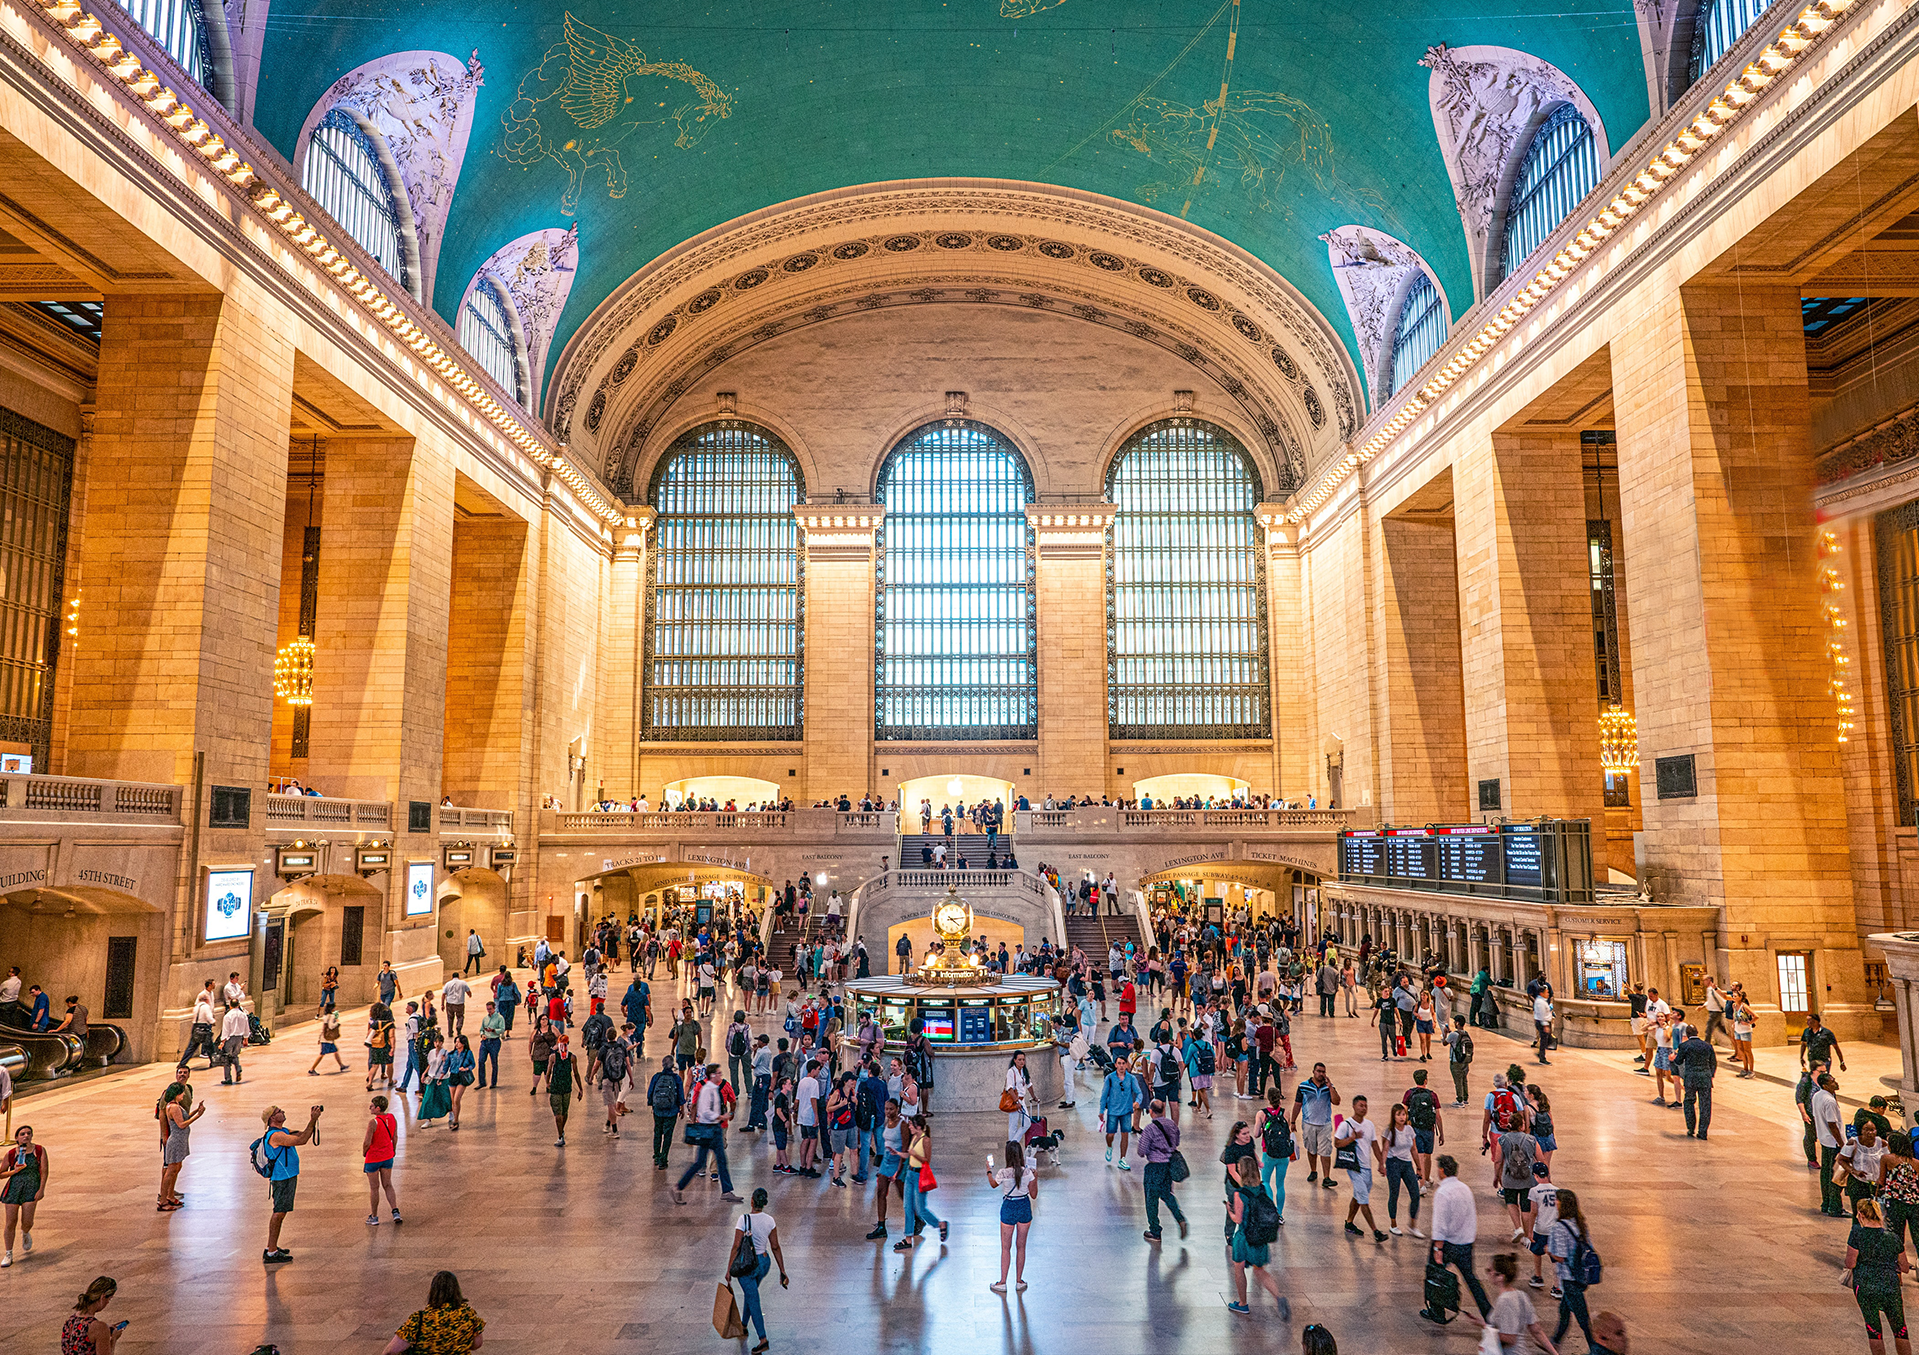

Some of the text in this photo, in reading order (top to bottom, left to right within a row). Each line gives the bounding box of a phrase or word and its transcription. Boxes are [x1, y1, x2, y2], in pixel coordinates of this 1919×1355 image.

[605, 858, 634, 869] TRACKS
[687, 854, 732, 866] LEXINGTON
[1164, 853, 1209, 867] LEXINGTON
[1251, 852, 1317, 868] TICKET MACHINES
[0, 869, 45, 888] UILDING
[79, 869, 136, 890] 45TH STREET
[654, 879, 671, 887] 42ND
[671, 875, 693, 883] STREET
[725, 873, 750, 881] SUBWAY
[1150, 873, 1171, 881] STREET
[901, 911, 920, 920] TRACKS
[941, 970, 974, 978] Information
[1542, 1194, 1556, 1207] 45
